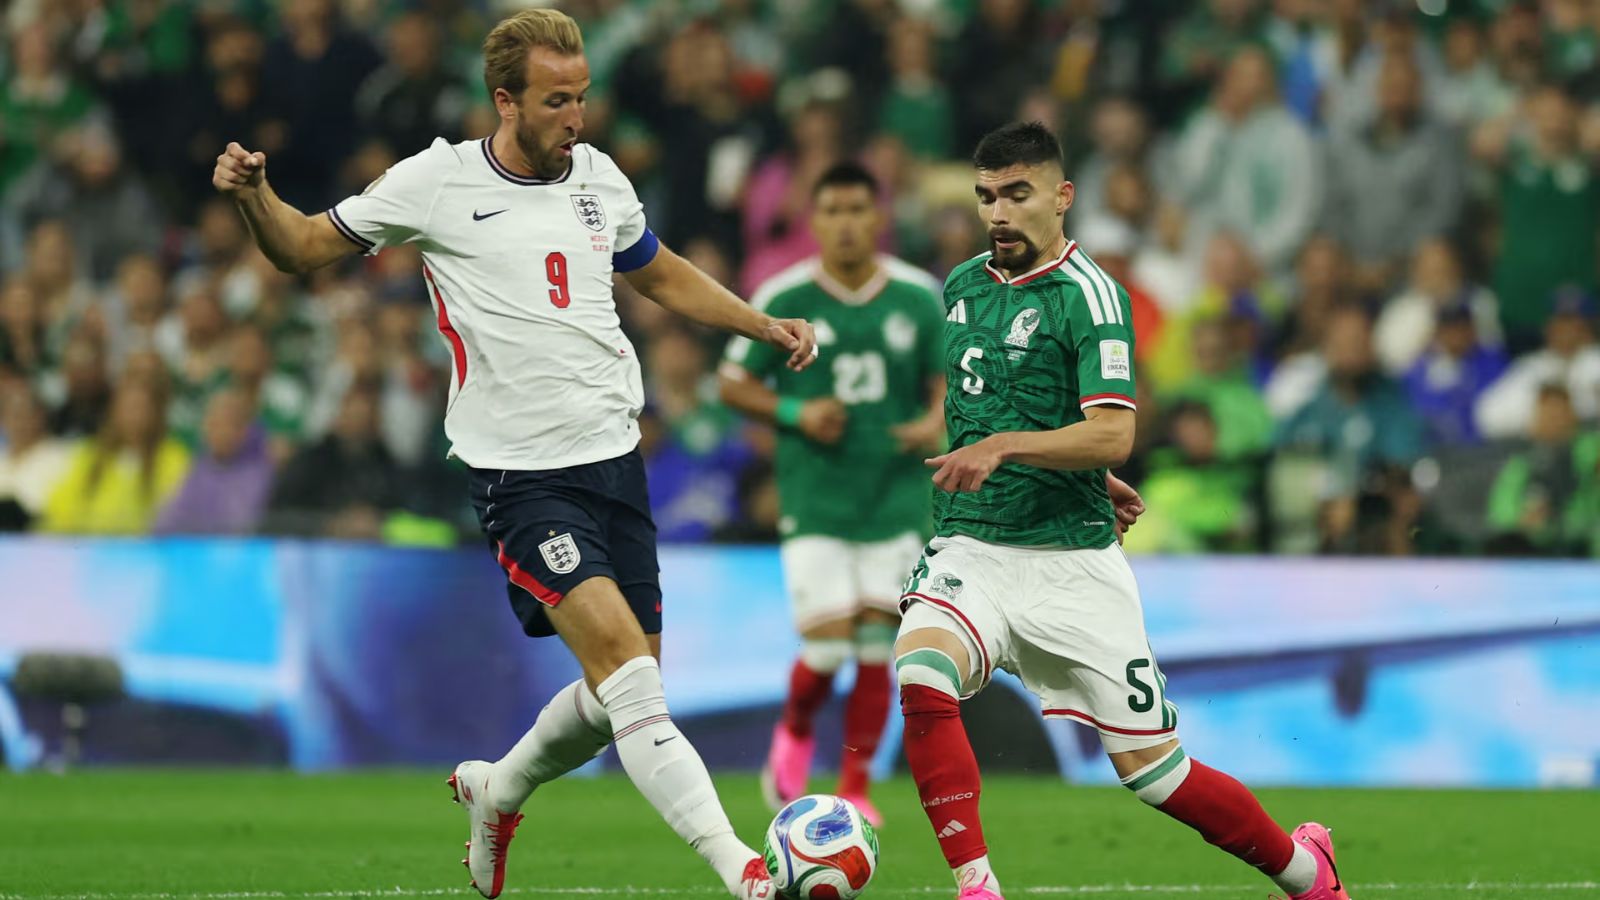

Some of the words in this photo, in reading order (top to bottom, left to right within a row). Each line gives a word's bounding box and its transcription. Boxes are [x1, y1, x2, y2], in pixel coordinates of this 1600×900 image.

[545, 252, 570, 308] 9
[833, 353, 886, 404] 23
[960, 347, 984, 395] 5
[1126, 658, 1154, 713] 5
